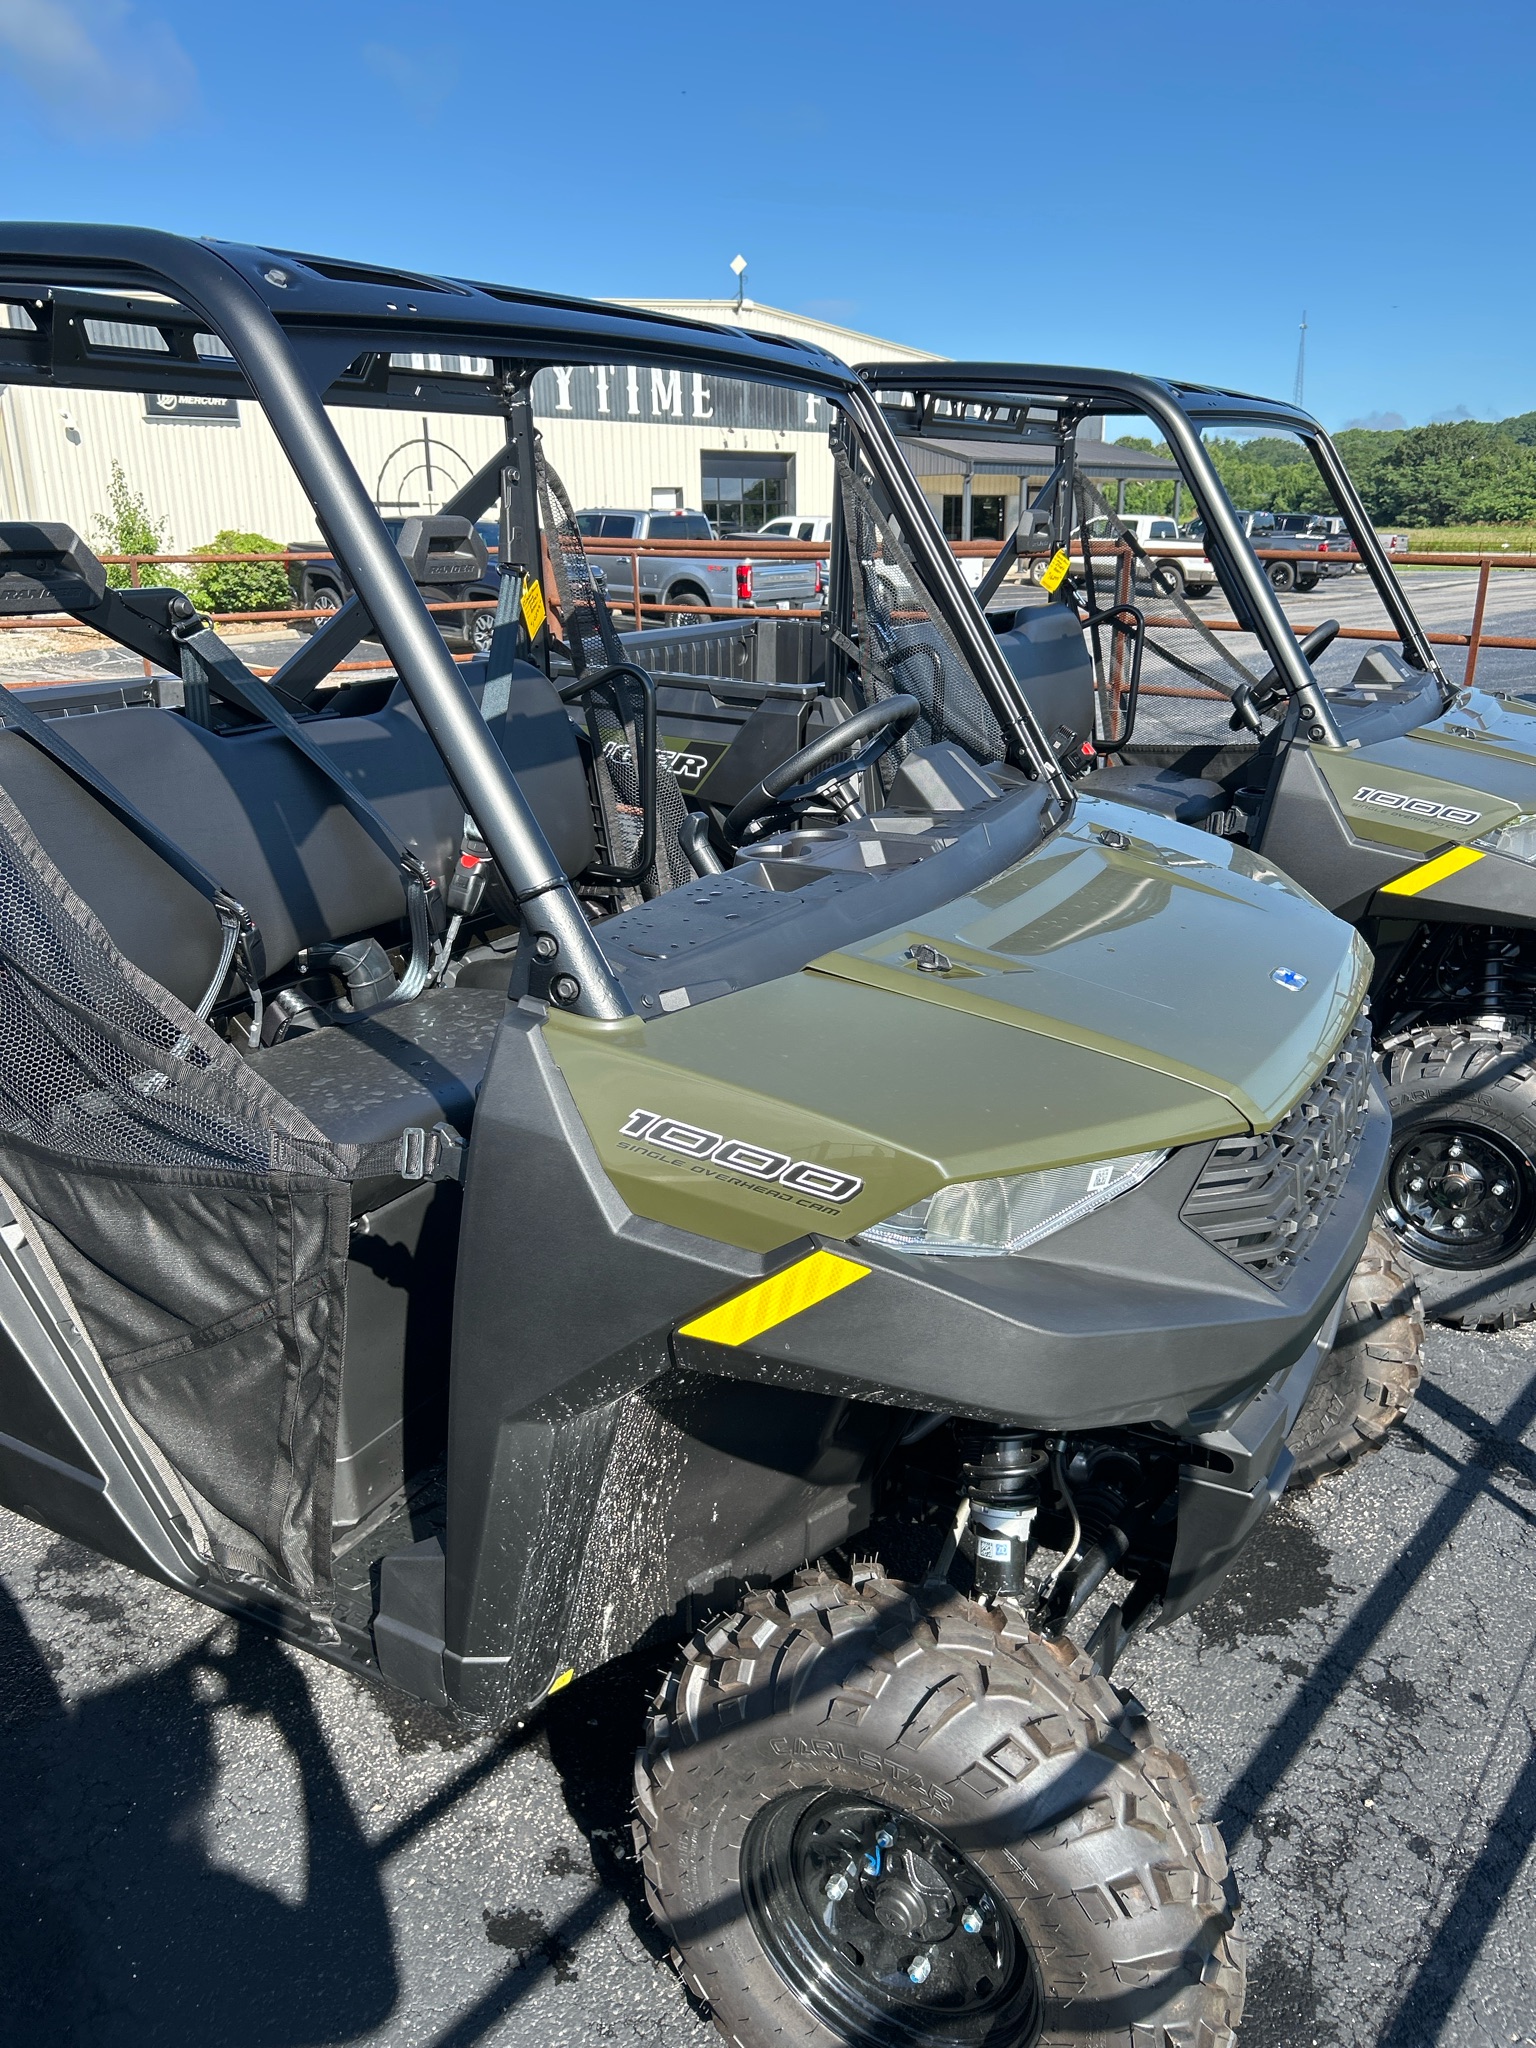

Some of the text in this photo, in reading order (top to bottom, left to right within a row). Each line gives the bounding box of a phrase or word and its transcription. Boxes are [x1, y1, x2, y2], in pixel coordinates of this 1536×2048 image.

[178, 396, 228, 406] MERCURY
[429, 564, 476, 575] RANGER
[1351, 802, 1469, 833] SINGLE OVERHEAD CAM
[1352, 786, 1482, 826] 1000
[618, 1108, 866, 1205] 1000
[616, 1141, 842, 1218] SINGLE OVERHEAD CAM
[769, 1737, 955, 1812] CARLSTAR
